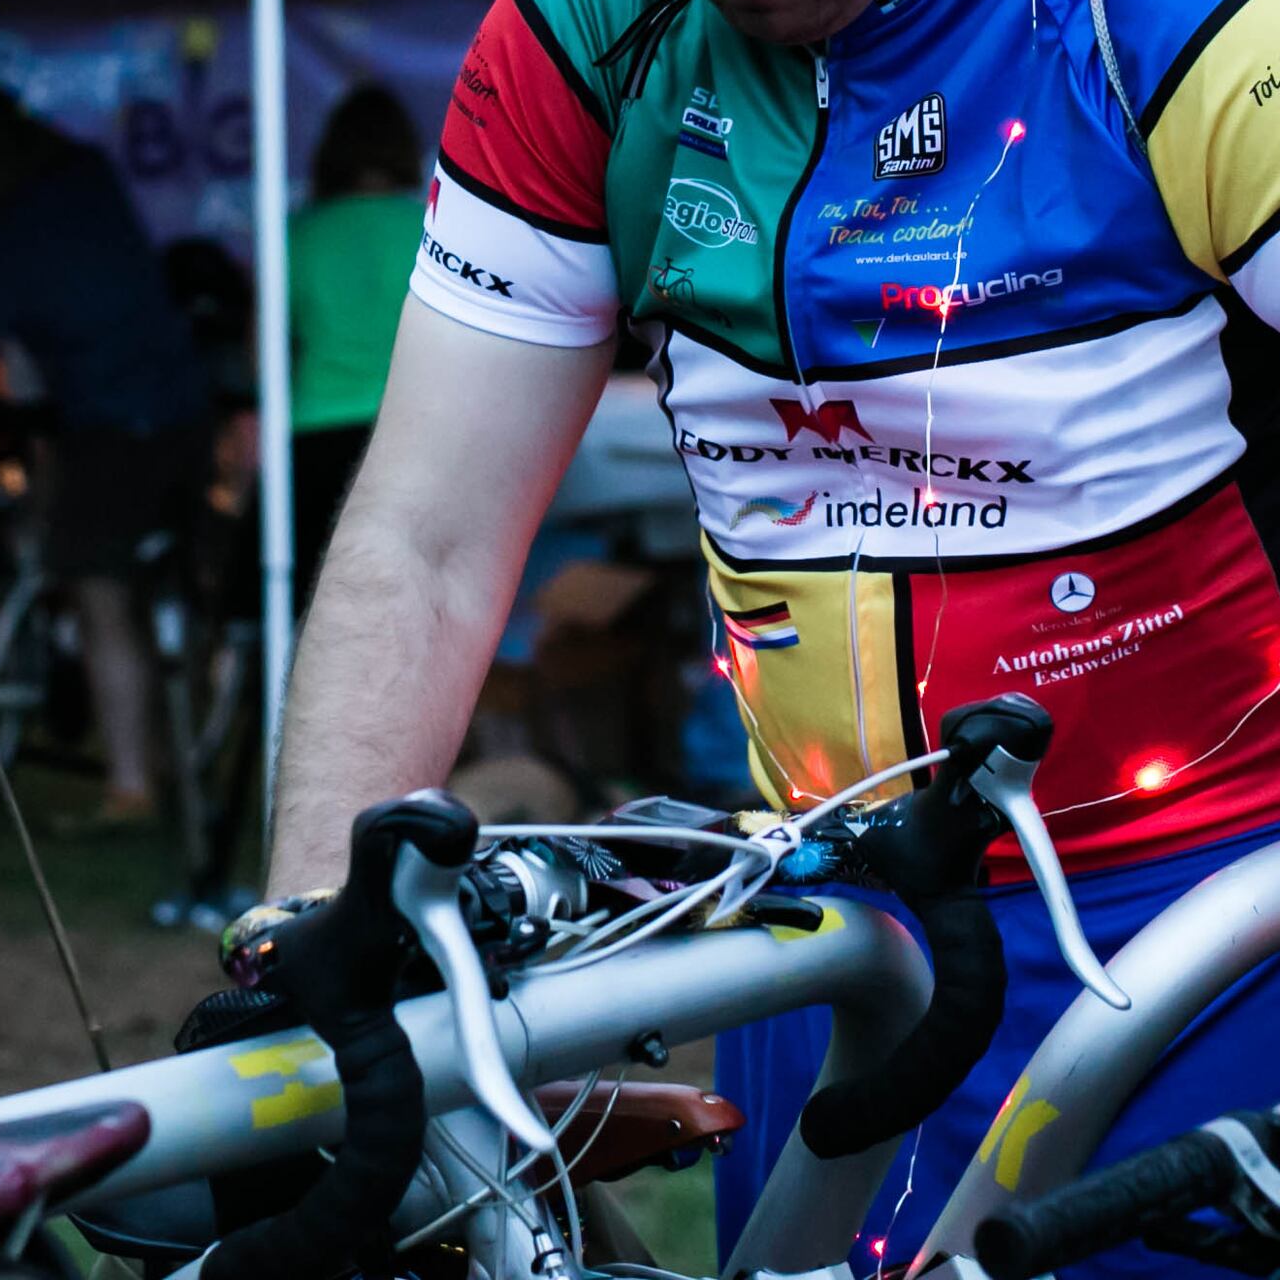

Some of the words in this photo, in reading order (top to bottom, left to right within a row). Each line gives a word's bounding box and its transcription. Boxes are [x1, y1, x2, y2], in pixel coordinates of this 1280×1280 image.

[879, 98, 942, 162] SMS
[829, 225, 885, 245] Team
[880, 268, 1064, 312] Procycling
[678, 428, 793, 462] EDDY
[811, 443, 1036, 484] MERCKX
[822, 486, 1009, 530] indeland
[993, 634, 1114, 675] Autohaus
[1118, 603, 1185, 643] Zittel
